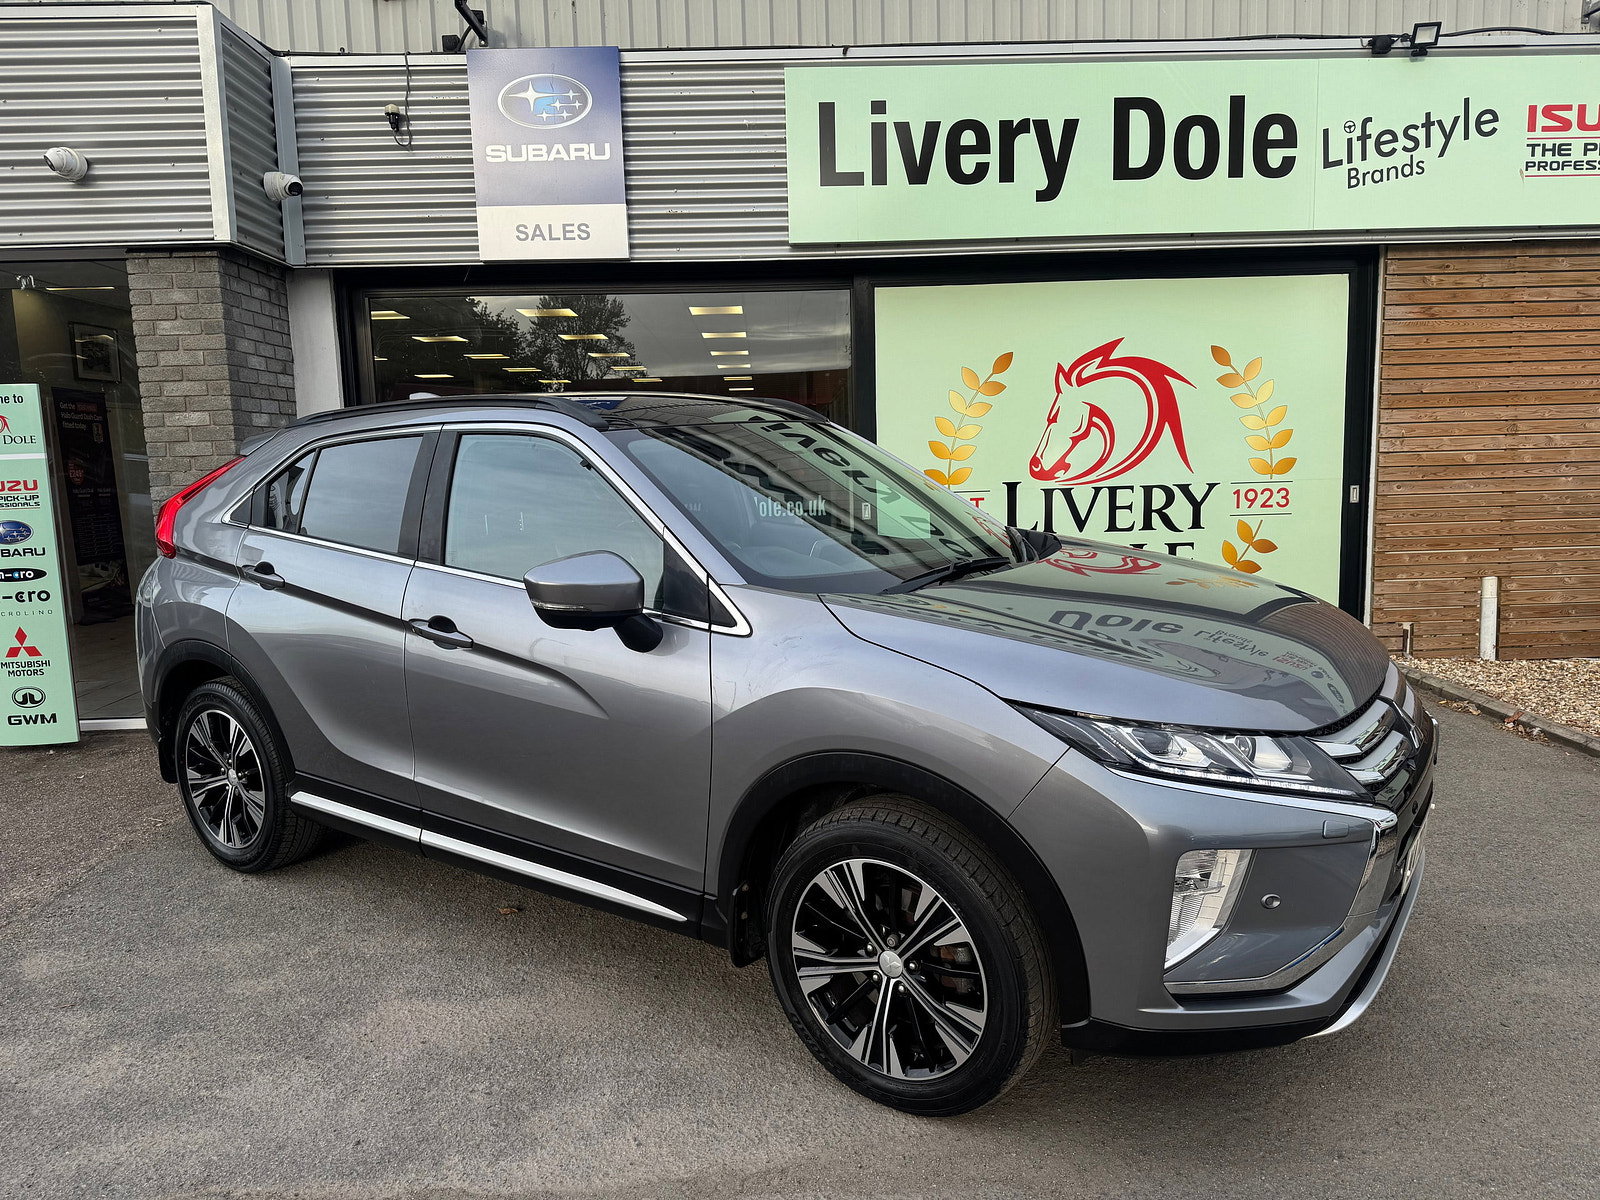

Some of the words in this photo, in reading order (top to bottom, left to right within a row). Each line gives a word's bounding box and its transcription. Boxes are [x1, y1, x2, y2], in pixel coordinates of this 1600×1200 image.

[1322, 97, 1500, 170] Lifestyle
[484, 142, 611, 163] SUBARU
[818, 99, 1080, 203] Livery
[1112, 94, 1299, 181] Dole
[1526, 142, 1572, 158] THE
[1583, 142, 1600, 157] P
[1346, 154, 1426, 190] Brands
[1524, 159, 1600, 172] PROFES
[515, 222, 592, 242] SALES
[12, 393, 24, 404] to
[3, 434, 37, 445] DOLE
[1232, 487, 1291, 509] 1923
[1002, 481, 1221, 534] LIVERY
[0, 659, 51, 669] MITSUBISHI
[7, 668, 45, 678] MOTORS
[7, 712, 58, 726] GWM
